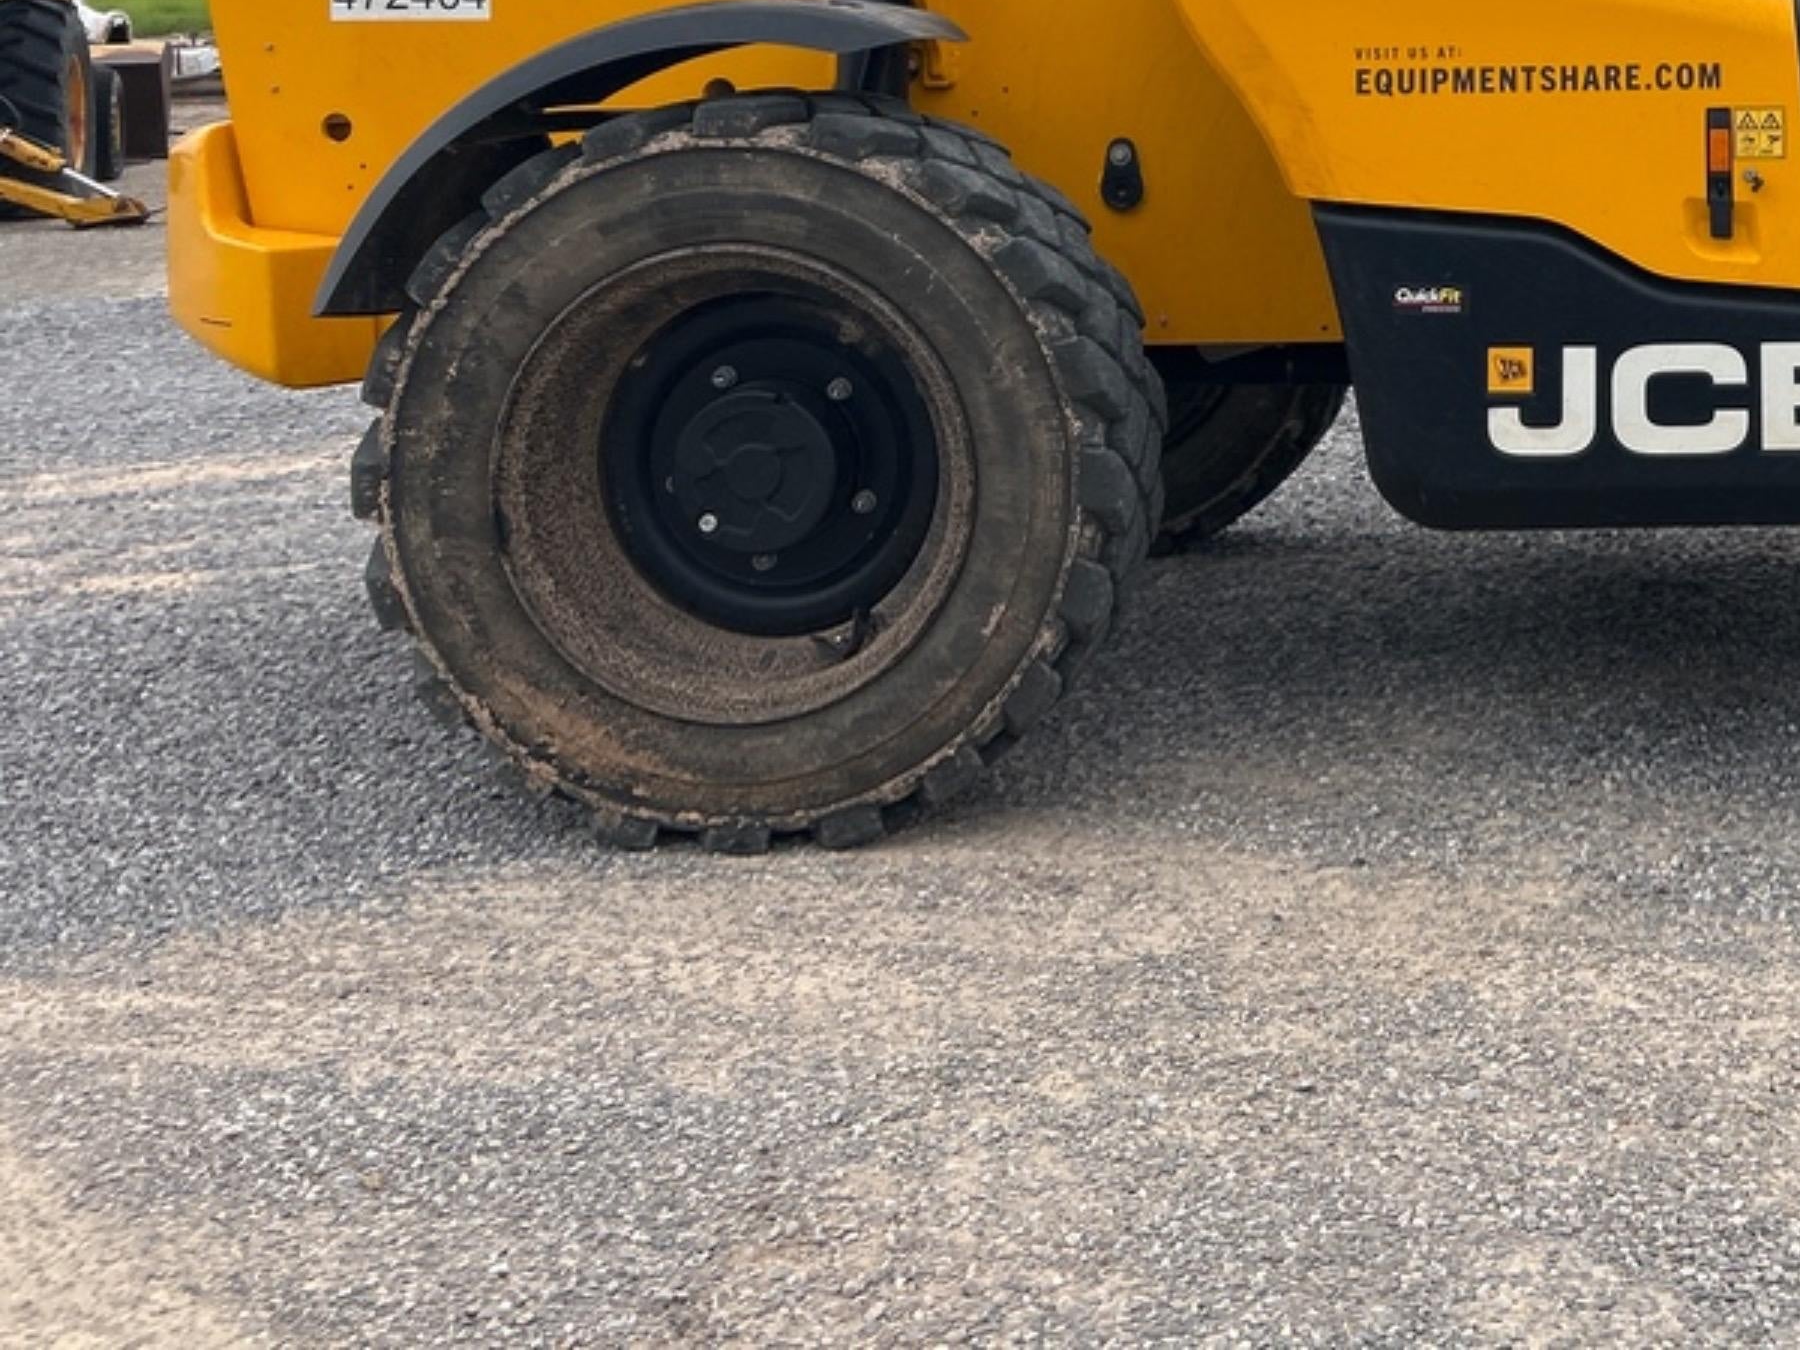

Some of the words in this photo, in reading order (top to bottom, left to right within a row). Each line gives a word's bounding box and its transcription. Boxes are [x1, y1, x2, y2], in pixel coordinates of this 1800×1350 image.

[1355, 47, 1399, 60] VISIT
[1408, 47, 1428, 59] US
[1355, 62, 1721, 97] EQUIPMENTSHARE.COM
